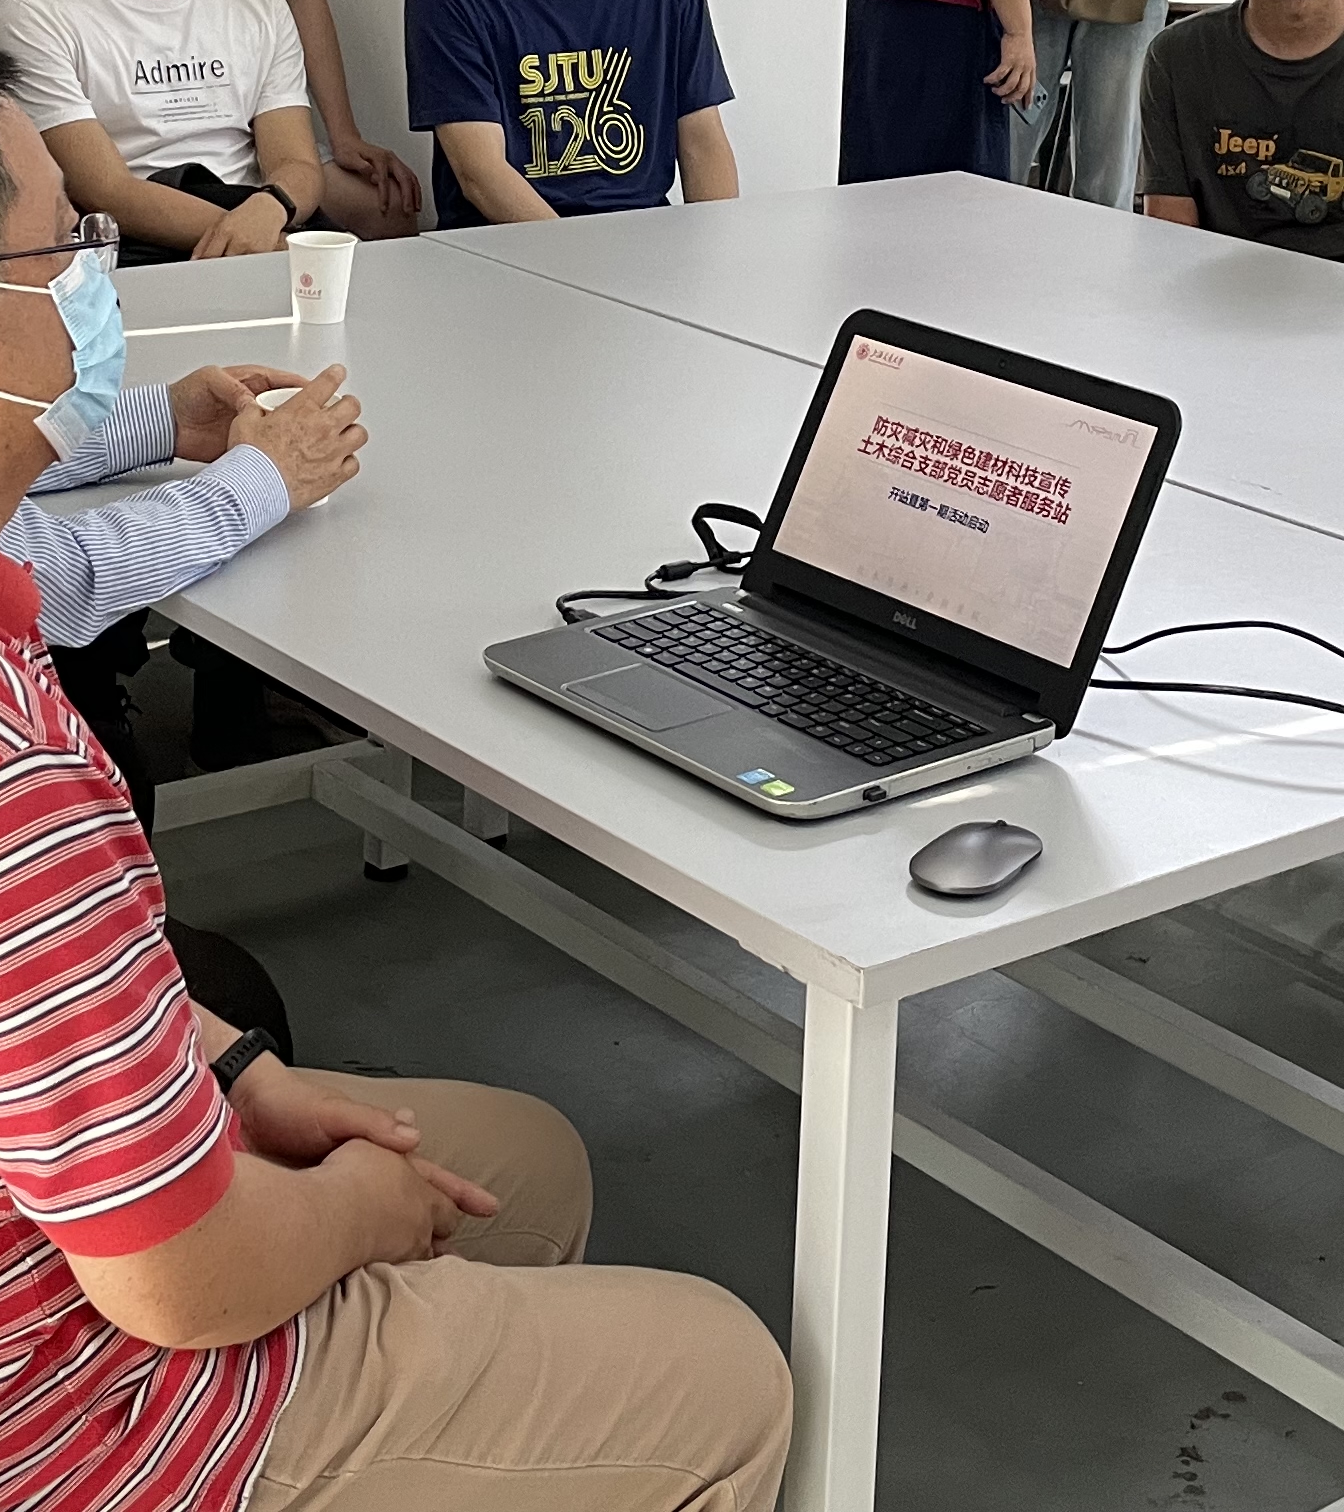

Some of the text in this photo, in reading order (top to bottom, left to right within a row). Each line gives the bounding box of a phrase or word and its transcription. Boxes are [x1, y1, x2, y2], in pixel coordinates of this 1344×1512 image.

[134, 55, 225, 86] Admire
[519, 49, 603, 96] SJTU
[519, 47, 644, 178] 126
[1214, 128, 1276, 161] Jeep
[857, 435, 1072, 526] 土木综合支部党员志愿者服务站
[871, 415, 1072, 500] 防灾减灾和绿色建材科技宣传
[892, 610, 917, 630] DELL
